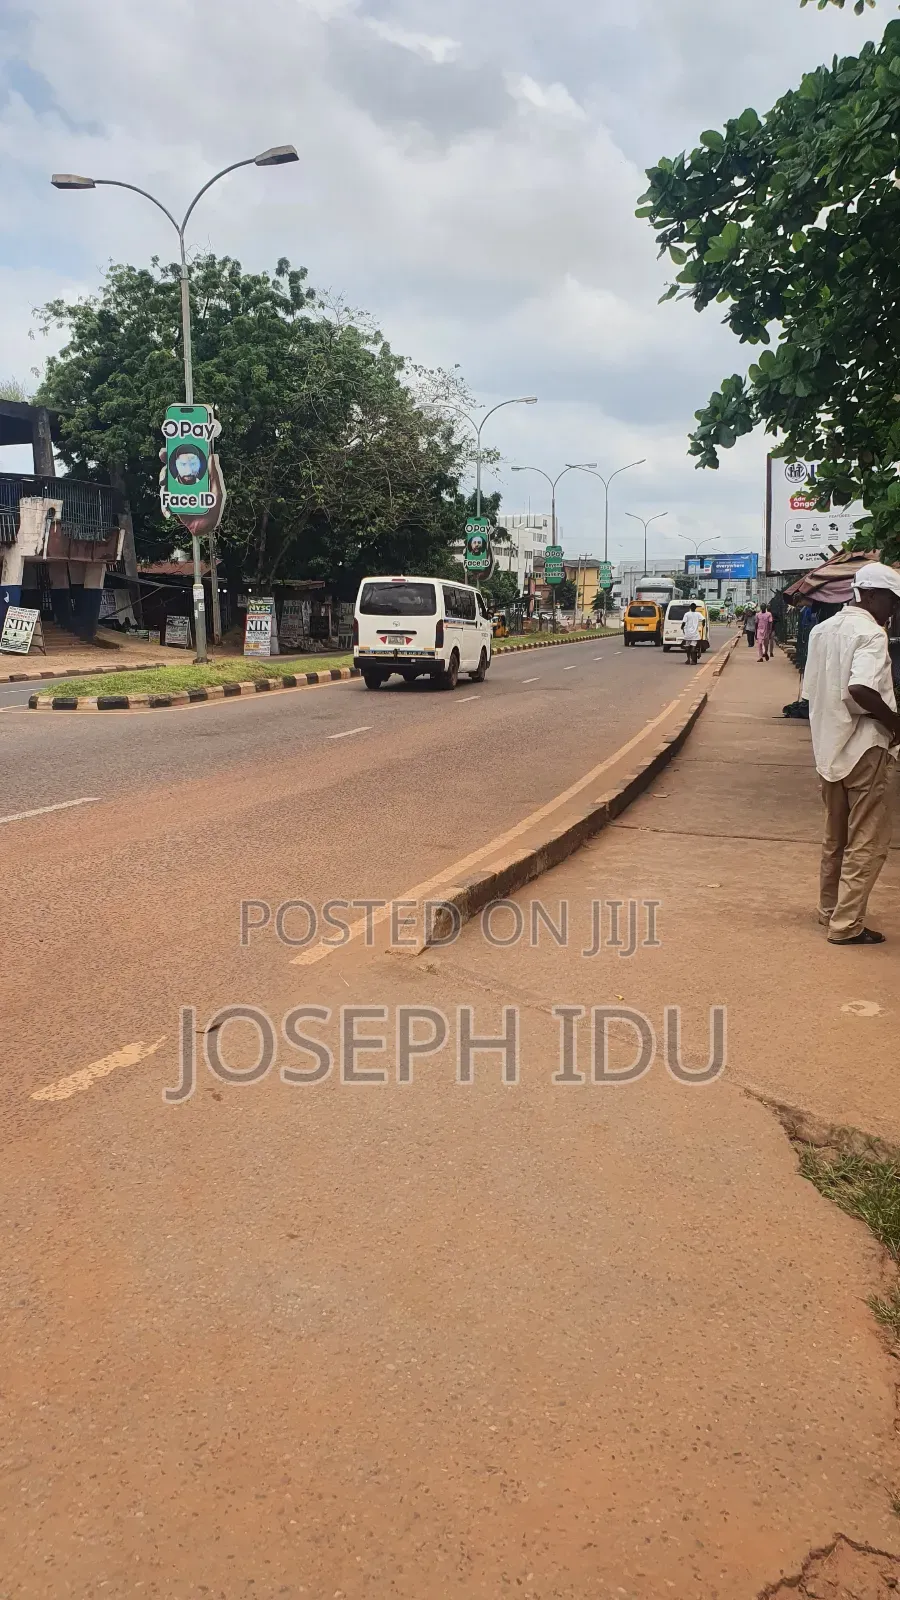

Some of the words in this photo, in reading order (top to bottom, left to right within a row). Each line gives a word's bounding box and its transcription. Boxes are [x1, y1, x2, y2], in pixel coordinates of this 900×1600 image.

[162, 420, 215, 439] OPay
[162, 493, 197, 507] Face
[201, 493, 215, 507] ID
[465, 524, 490, 534] OPay
[464, 559, 480, 567] Face
[481, 559, 490, 567] ID
[249, 604, 272, 612] NYSC
[6, 619, 34, 631] NIN
[246, 620, 272, 631] NIN
